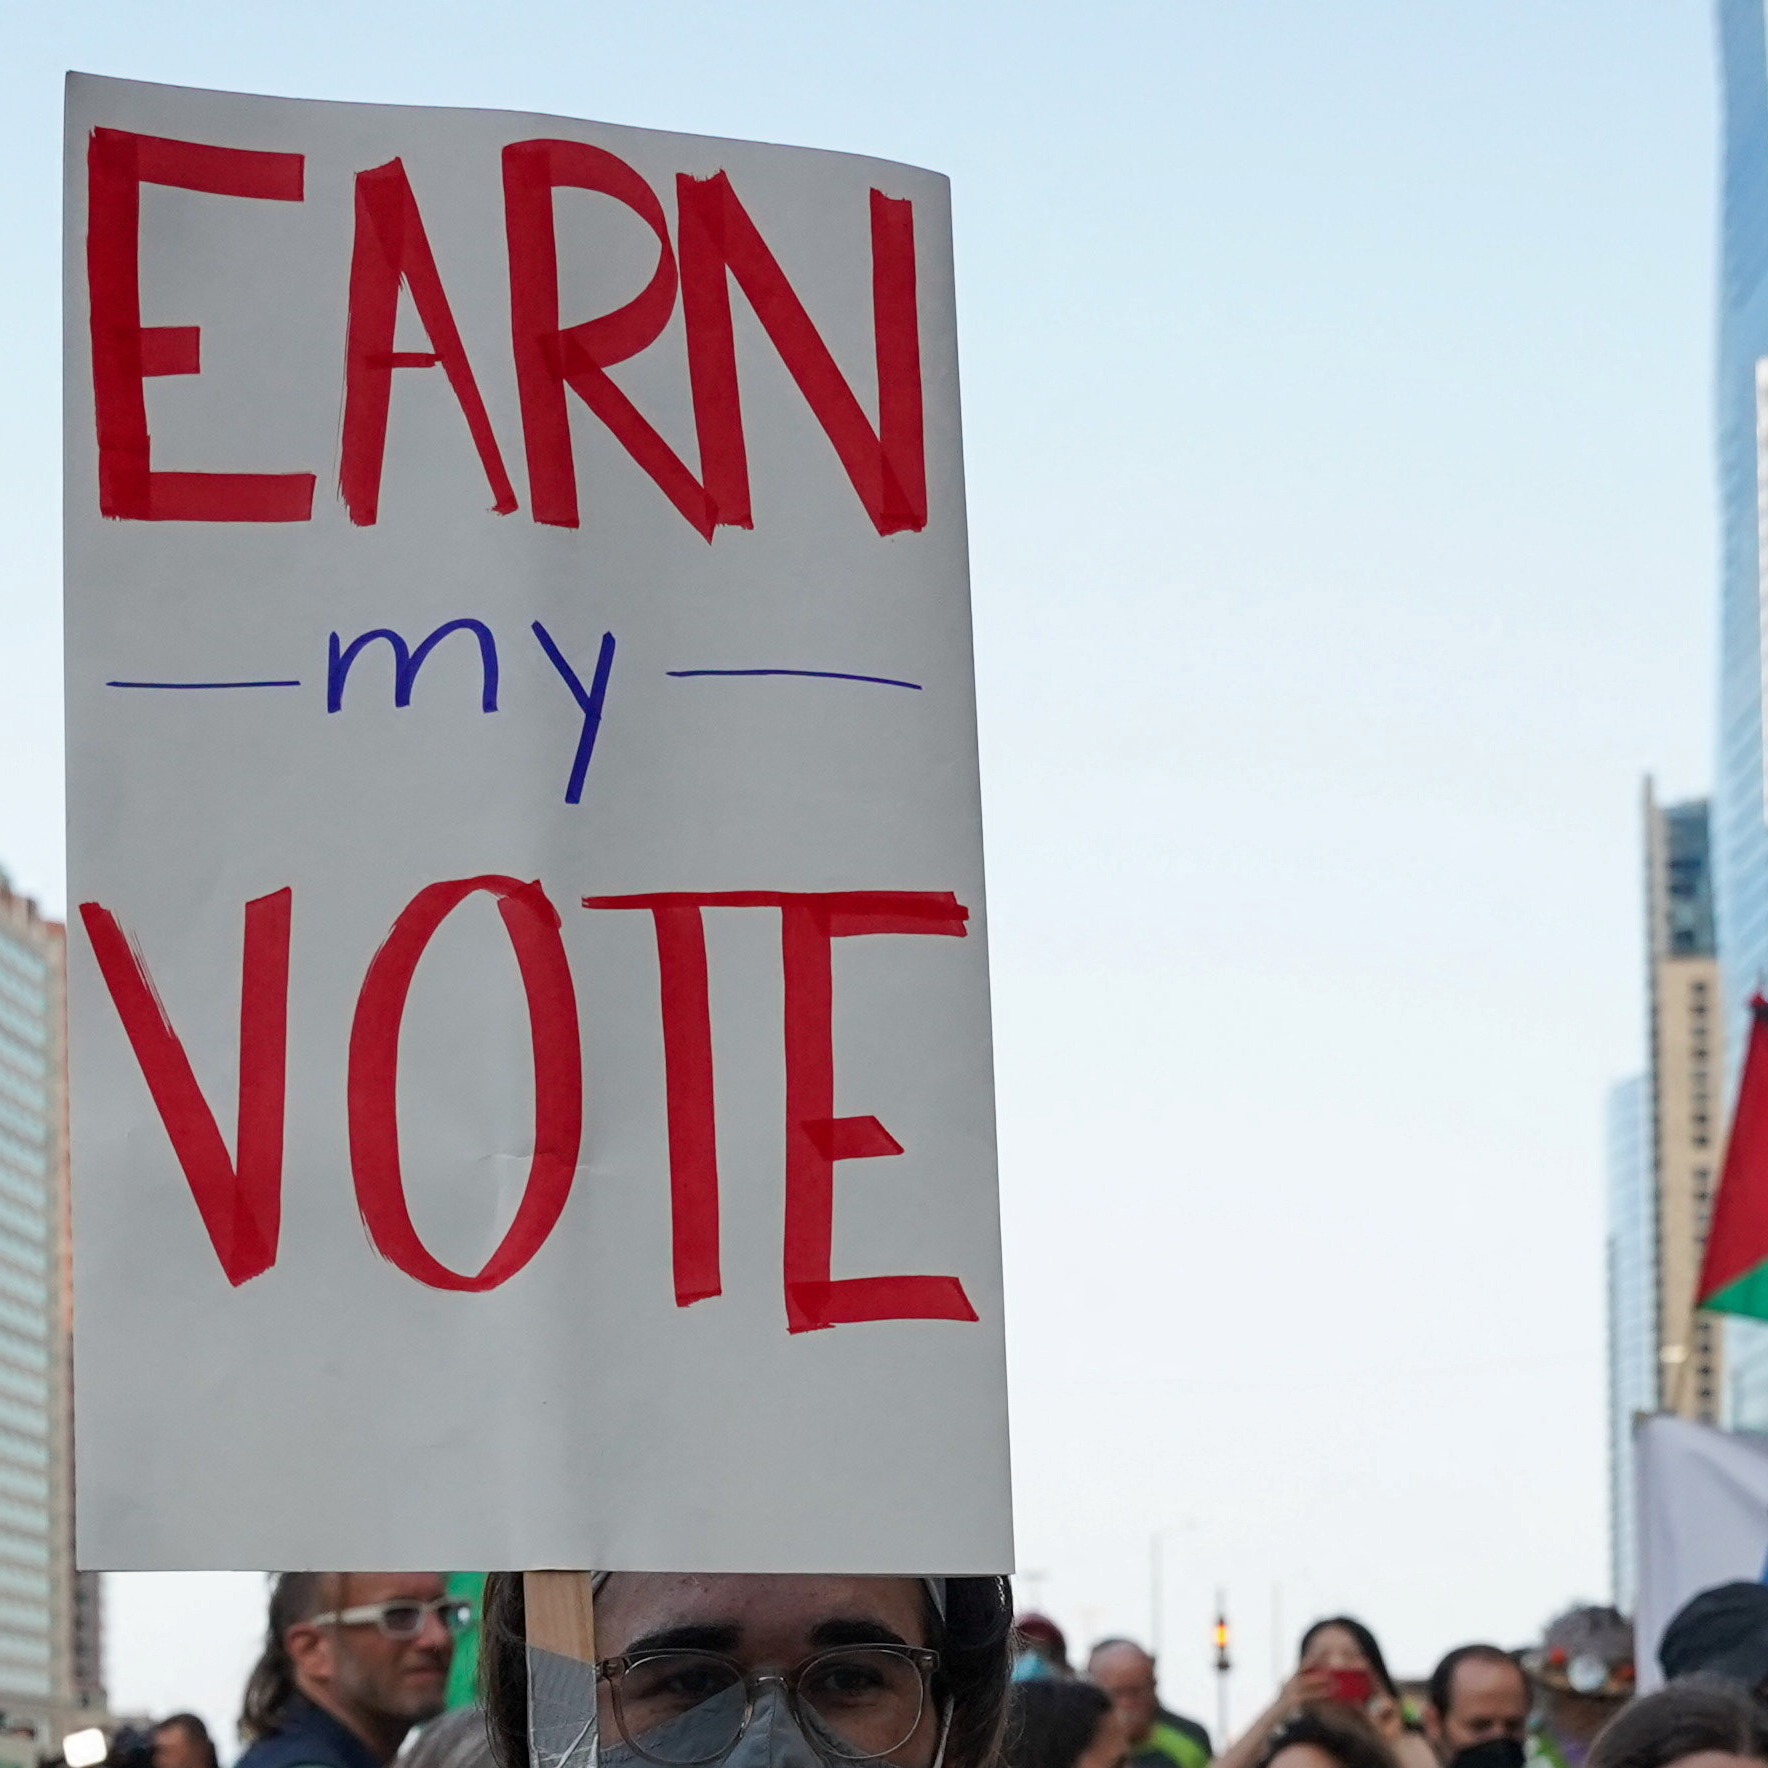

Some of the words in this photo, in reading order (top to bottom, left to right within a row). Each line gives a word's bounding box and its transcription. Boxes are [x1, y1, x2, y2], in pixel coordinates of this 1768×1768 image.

[87, 125, 927, 546] EARN
[327, 618, 616, 803] my
[78, 874, 979, 1335] VOTE
